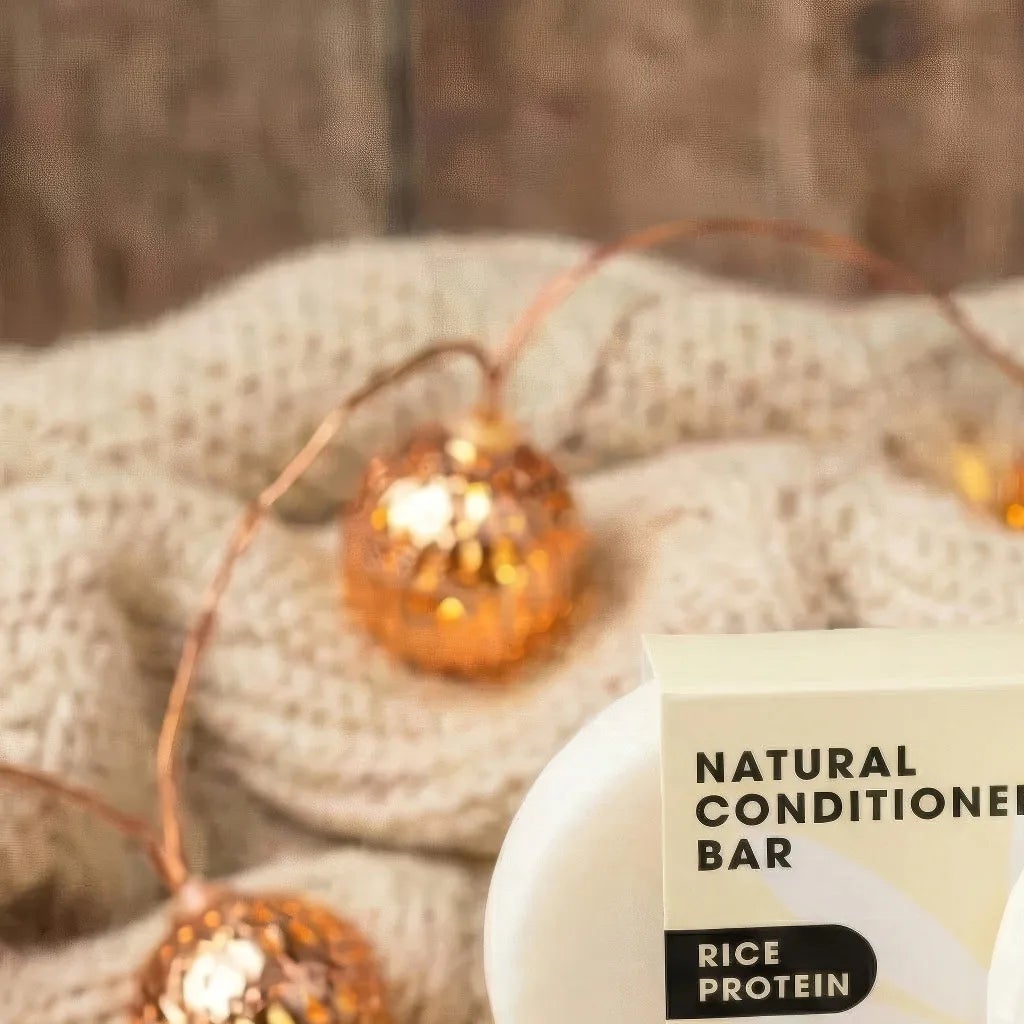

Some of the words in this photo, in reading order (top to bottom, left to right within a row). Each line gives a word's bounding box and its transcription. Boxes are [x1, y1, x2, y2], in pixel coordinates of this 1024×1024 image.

[696, 745, 916, 784] NATURAL
[697, 836, 793, 872] BAR
[698, 940, 780, 968] RICE
[698, 973, 850, 1002] PROTEIN
